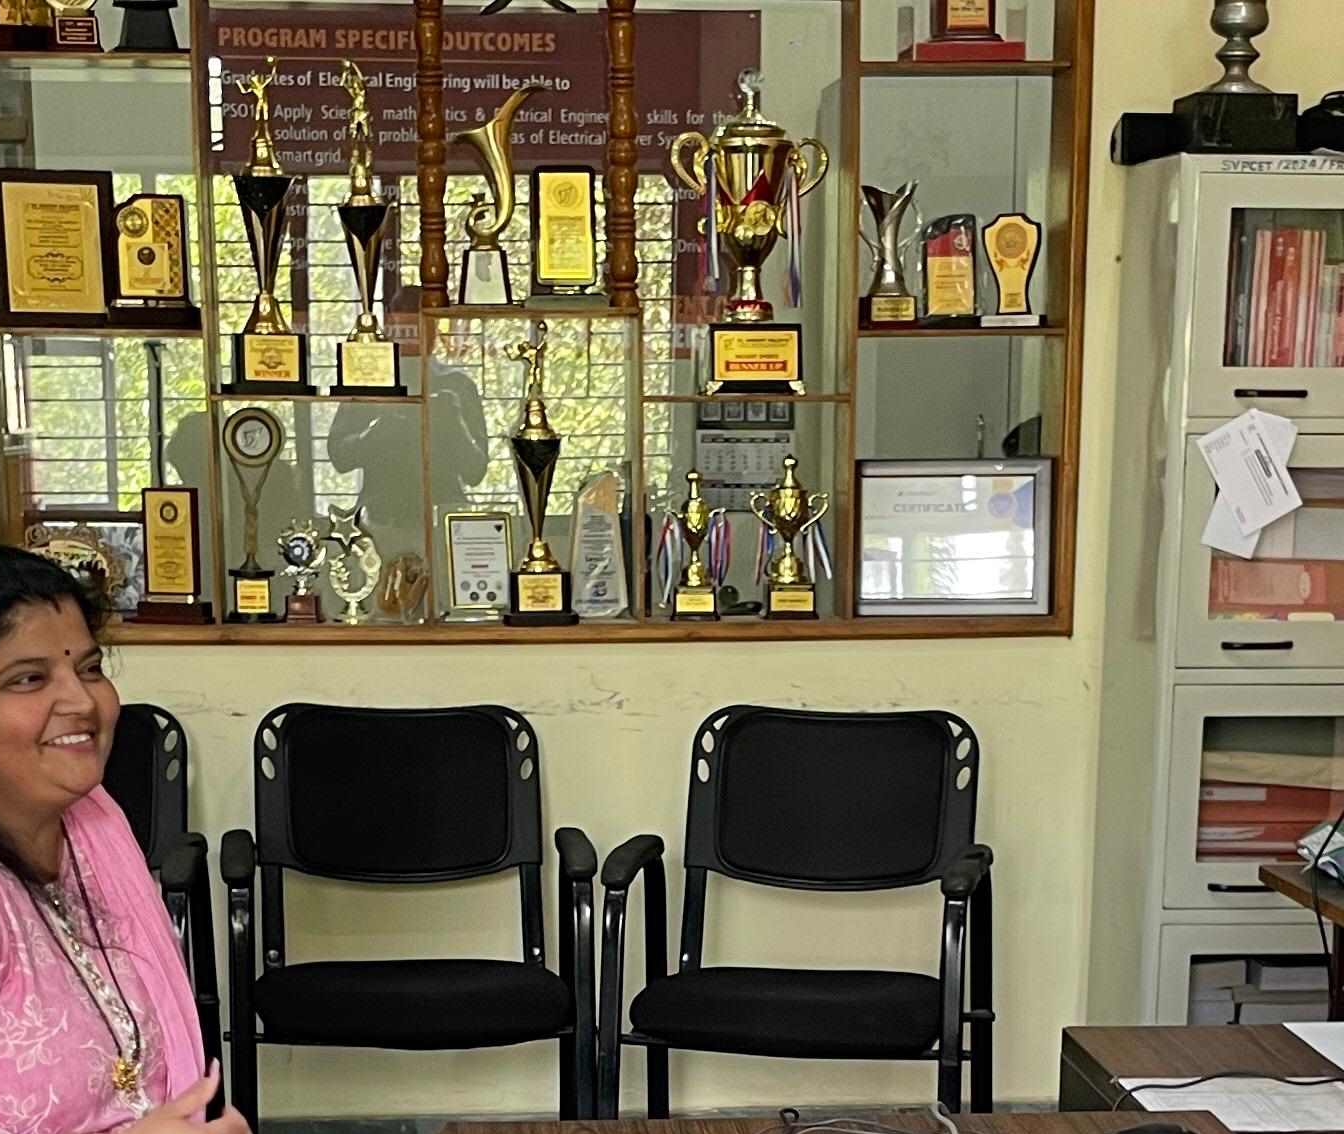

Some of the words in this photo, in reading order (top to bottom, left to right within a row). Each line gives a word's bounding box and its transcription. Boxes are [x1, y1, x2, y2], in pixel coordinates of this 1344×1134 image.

[218, 27, 326, 49] PROGRAM
[335, 29, 417, 50] SPECIFI
[442, 31, 556, 52] OUTCOMES
[297, 71, 312, 87] of
[473, 74, 500, 90] will
[502, 74, 520, 90] be
[555, 77, 570, 91] to
[273, 104, 313, 122] Apply
[475, 106, 486, 122] &
[647, 108, 678, 125] skills
[686, 109, 705, 125] for
[274, 126, 329, 141] solution
[332, 126, 346, 141] of
[529, 129, 544, 145] of
[549, 130, 607, 146] Electrical
[276, 149, 312, 163] smart
[1222, 160, 1273, 172] SVPCET
